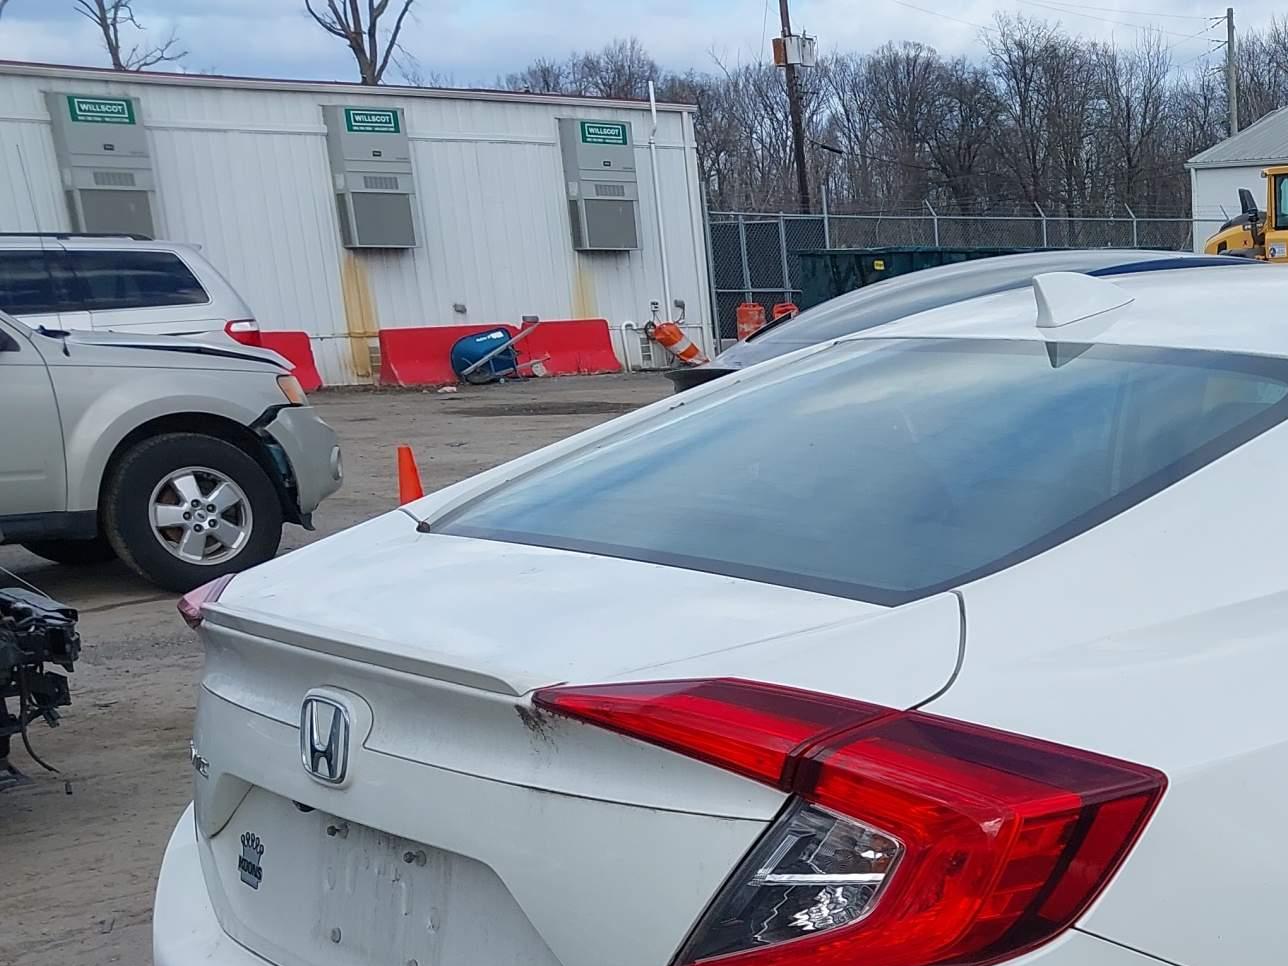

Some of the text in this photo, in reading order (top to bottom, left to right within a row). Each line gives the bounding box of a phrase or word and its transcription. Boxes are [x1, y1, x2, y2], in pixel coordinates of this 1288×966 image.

[79, 103, 123, 113] WILLSCOT
[354, 114, 390, 123] WILLSCOT
[588, 127, 620, 136] WILLSCOT
